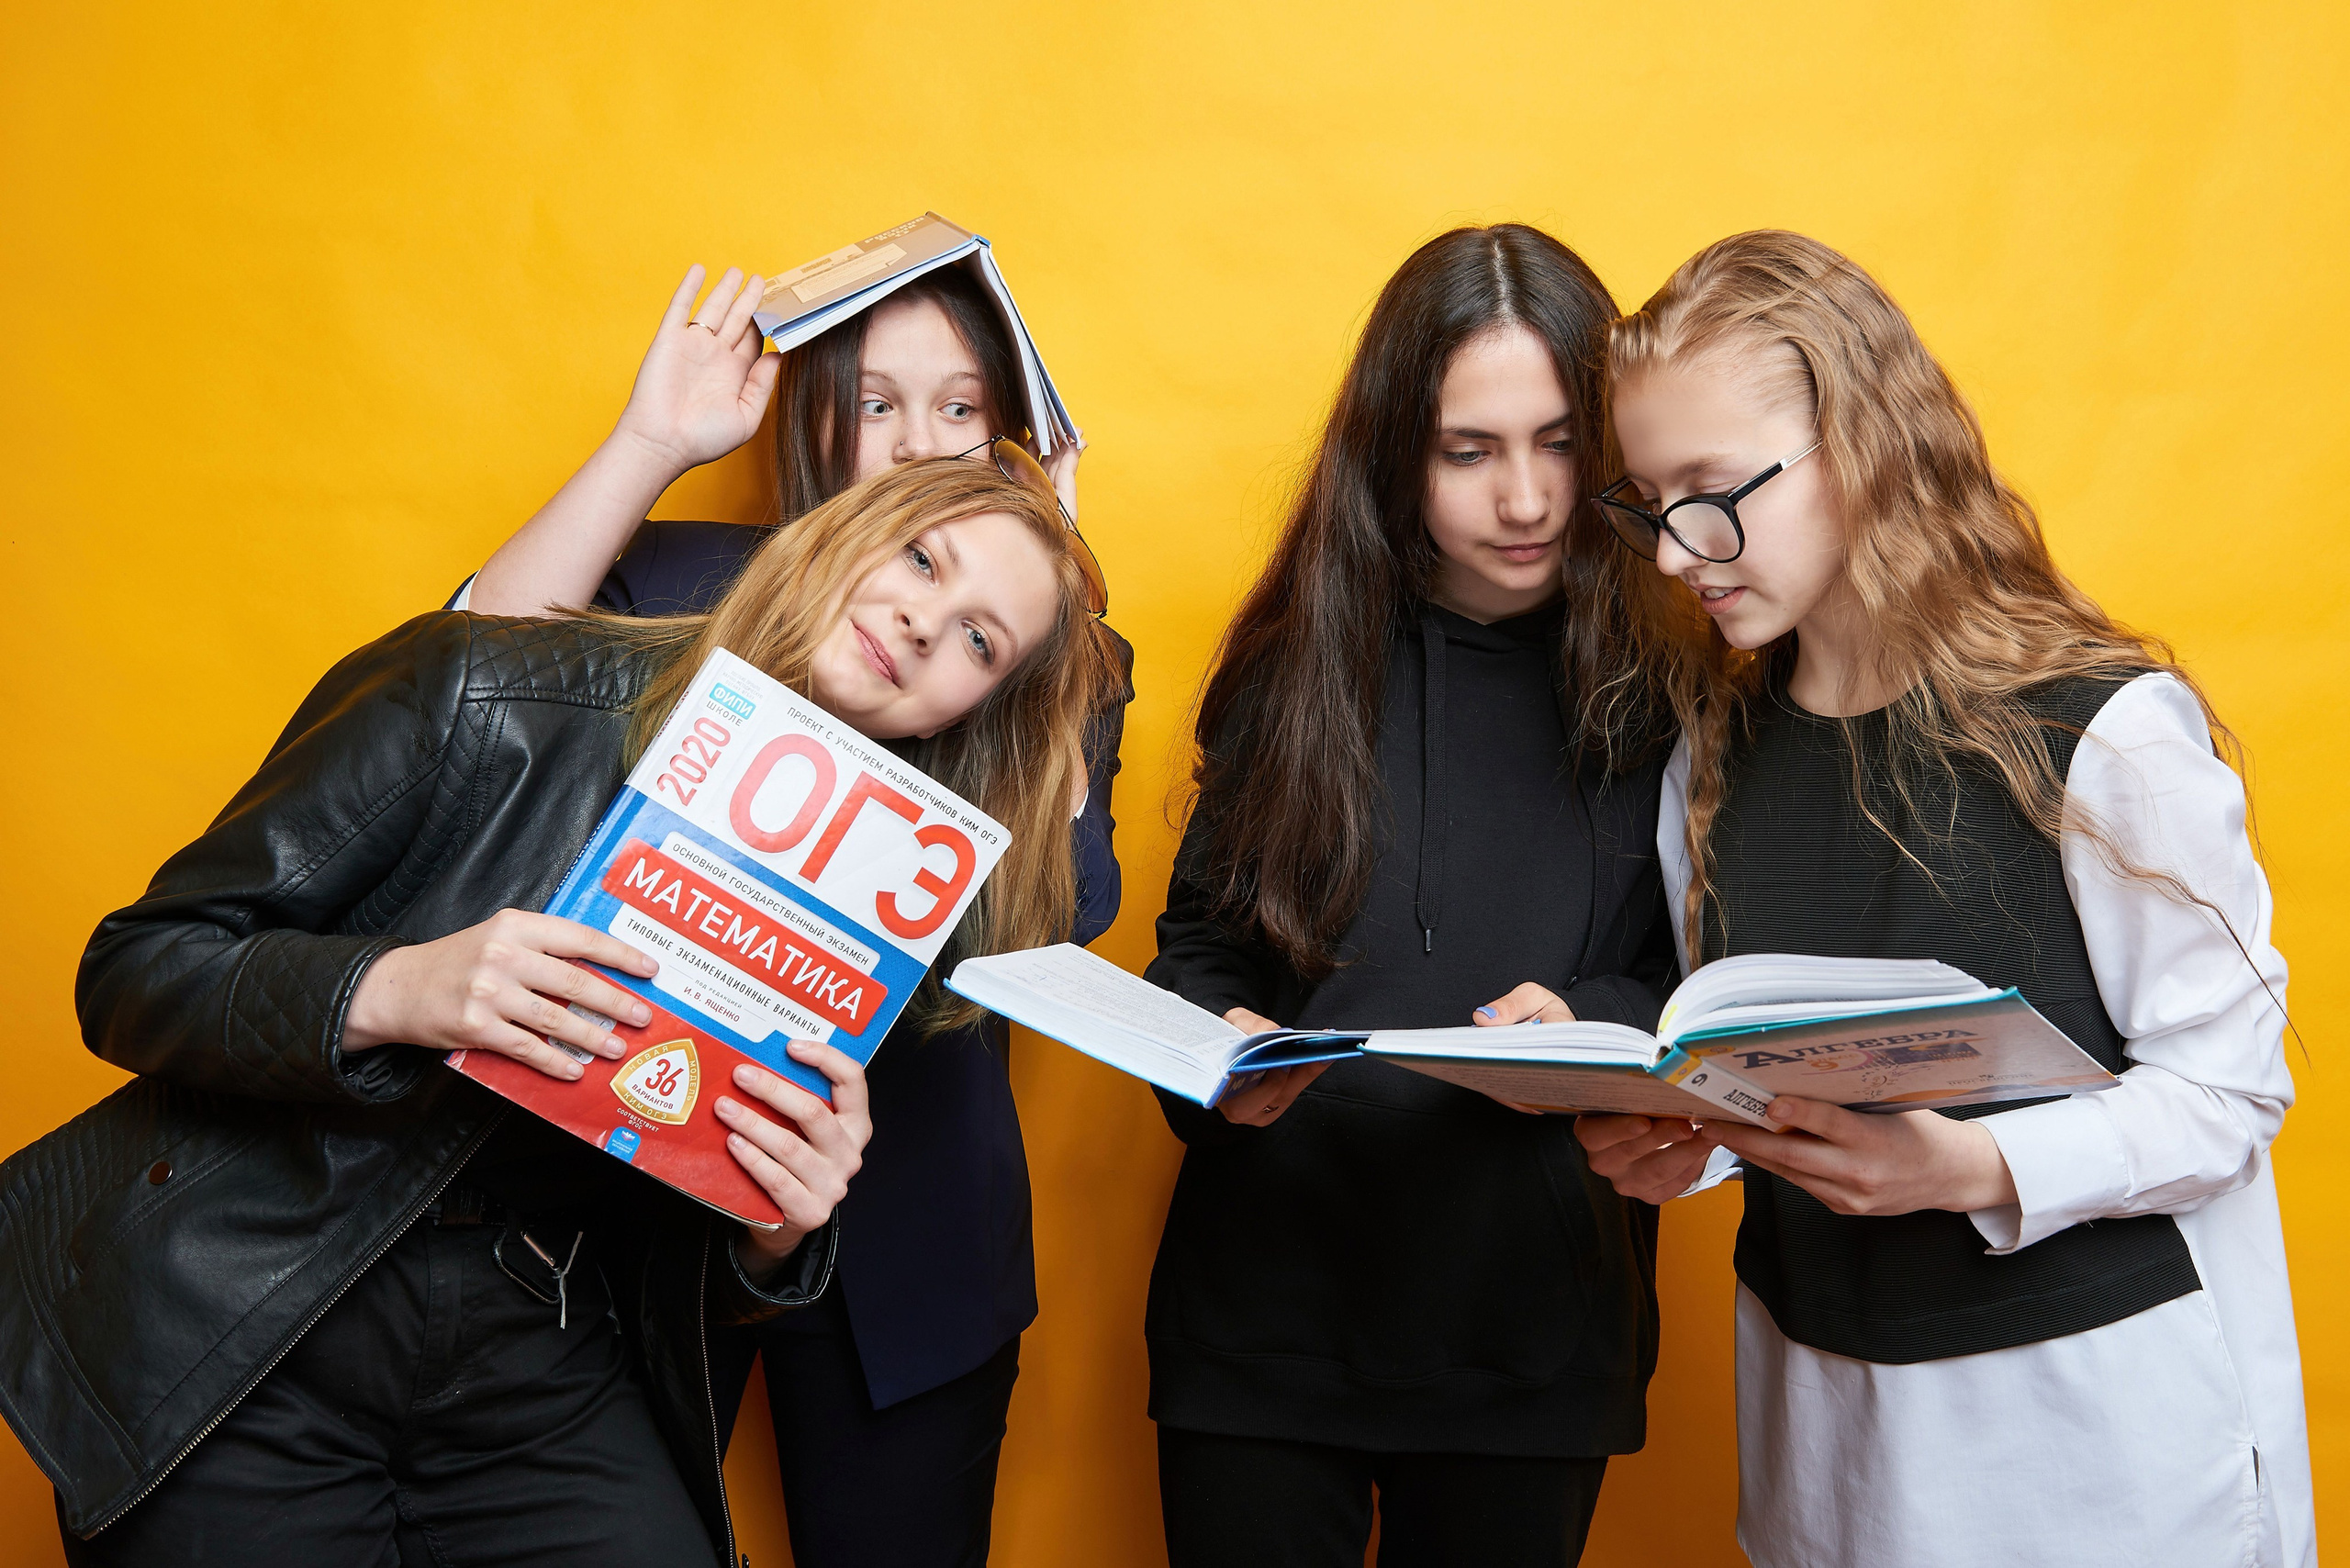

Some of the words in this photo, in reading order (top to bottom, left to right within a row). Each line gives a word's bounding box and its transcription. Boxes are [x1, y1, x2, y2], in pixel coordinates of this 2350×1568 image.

[706, 700, 744, 726] ШКОЛЕ
[713, 687, 753, 717] ФИПИ
[656, 717, 732, 807] 2020
[787, 707, 824, 734] ПРОЕКТ
[825, 731, 834, 740] С
[834, 736, 885, 771] УЧАСТИЕМ
[885, 768, 958, 819] РАЗРАБОТЧИКОВ
[958, 815, 979, 833] КИМ
[980, 830, 999, 846] ОГЭ
[729, 733, 977, 941] ОГЭ
[672, 842, 728, 879] ОСНОВНОЙ
[728, 875, 826, 939] ГОСУДАРСТВЕННЫЙ
[825, 935, 869, 966] ЭКЗАМЕН
[623, 857, 866, 1021] МАТЕМАТИКА
[626, 918, 674, 951] ТИПОВЫЕ
[676, 947, 772, 1008] ЭКЗАМЕНАЦИОННЫЕ
[772, 1003, 821, 1036] ВАРИАНТЫ
[684, 986, 693, 996] И.
[693, 992, 701, 1002] В.
[704, 998, 740, 1023] ЯЩЕНКО
[709, 987, 743, 1009] РЕДАКЦИЕЙ
[629, 1046, 669, 1071] НОВАЯ
[1733, 1028, 1978, 1070] АЛГЕБРА
[1810, 1059, 1839, 1071] 9
[644, 1058, 684, 1097] 36
[687, 1060, 698, 1102] МОДЕЛЬ
[1691, 1073, 1708, 1087] 9
[623, 1092, 644, 1110] КИМ
[646, 1108, 667, 1120] ОГЭ
[632, 1083, 674, 1110] ВАРИАНТОВ
[616, 1107, 659, 1133] СООТВЕТСТВУЕТ
[628, 1119, 643, 1130] ФГОС
